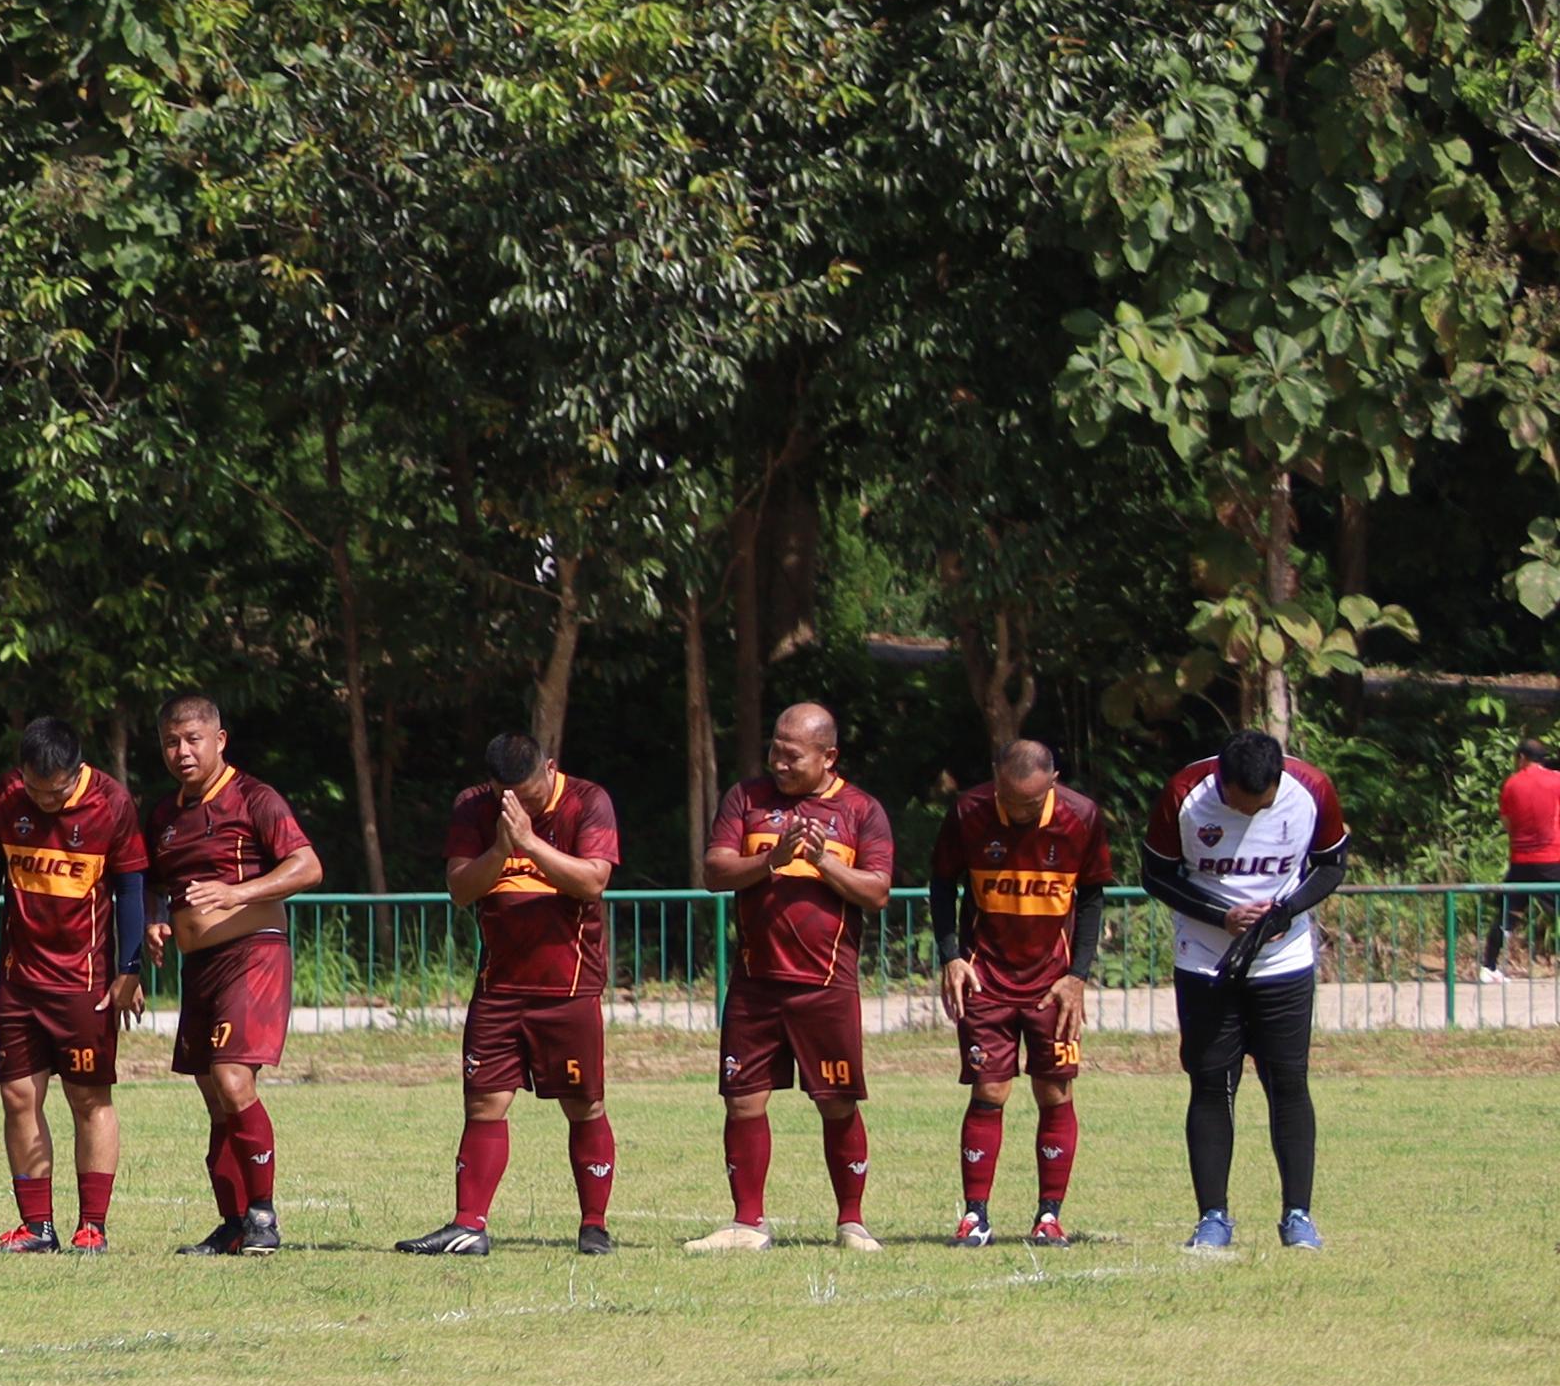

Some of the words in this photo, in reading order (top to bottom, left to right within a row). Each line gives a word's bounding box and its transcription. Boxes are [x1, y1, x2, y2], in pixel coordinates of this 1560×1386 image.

[9, 854, 87, 879] POLICE
[1199, 854, 1295, 876] POLICE
[983, 878, 1066, 897] POLICE
[70, 1048, 95, 1073] 38
[567, 1059, 580, 1084] 5
[821, 1060, 851, 1085] 49
